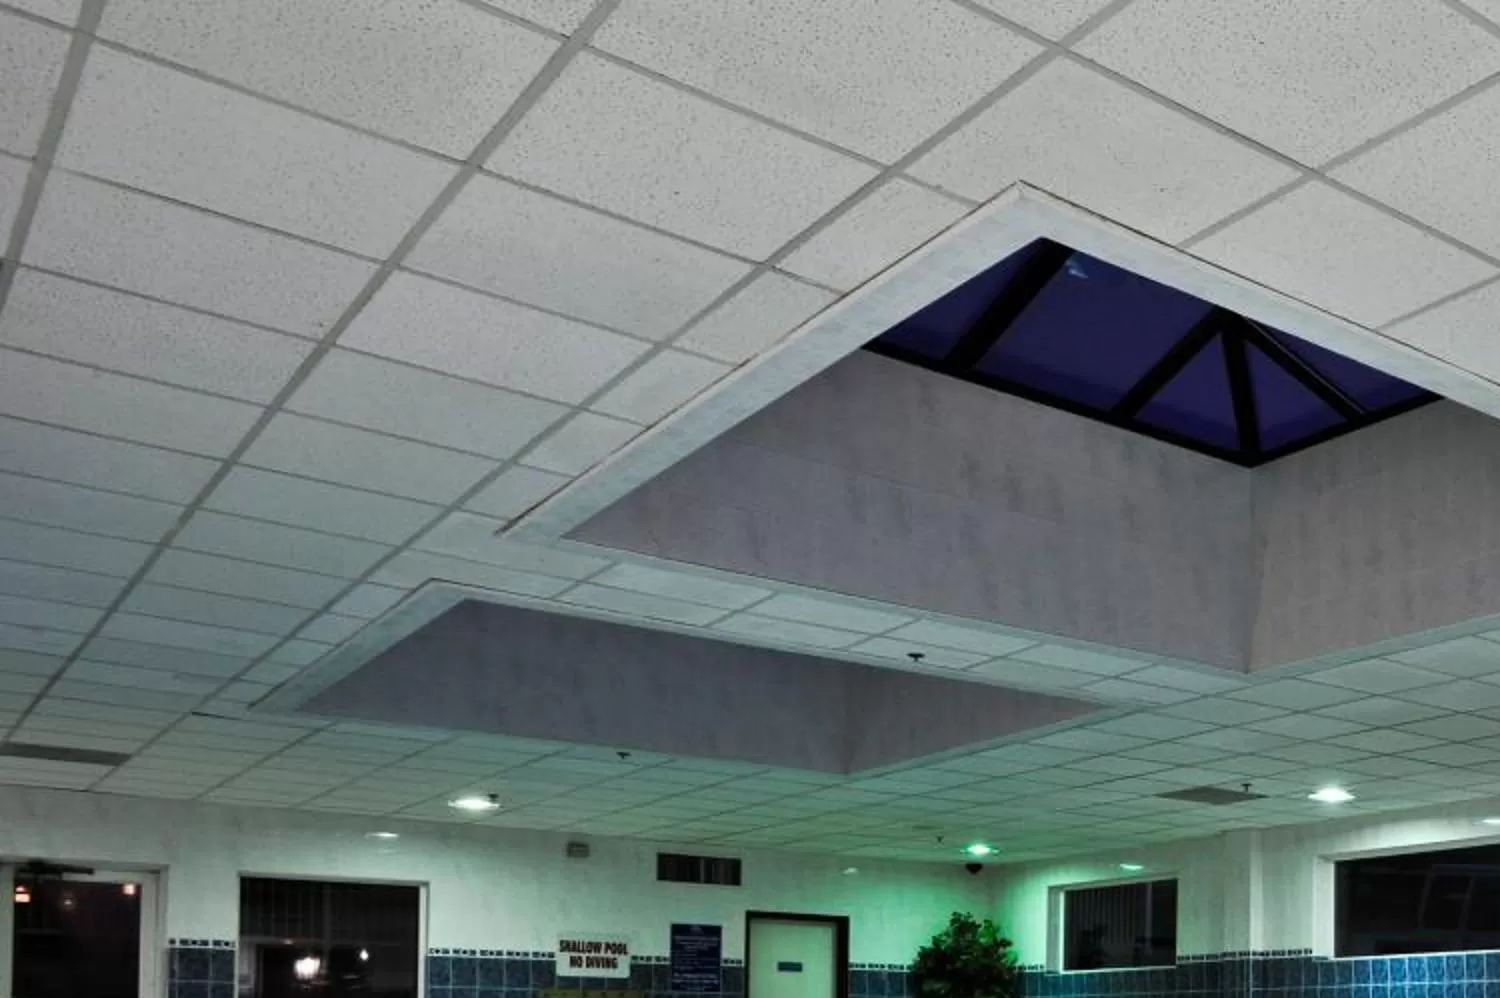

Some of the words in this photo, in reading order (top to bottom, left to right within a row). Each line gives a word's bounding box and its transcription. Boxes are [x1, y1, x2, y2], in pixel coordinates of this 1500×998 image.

[559, 939, 602, 954] SHALLOW
[604, 941, 629, 956] POOL
[570, 955, 583, 968] NO
[585, 955, 618, 969] DIVING
